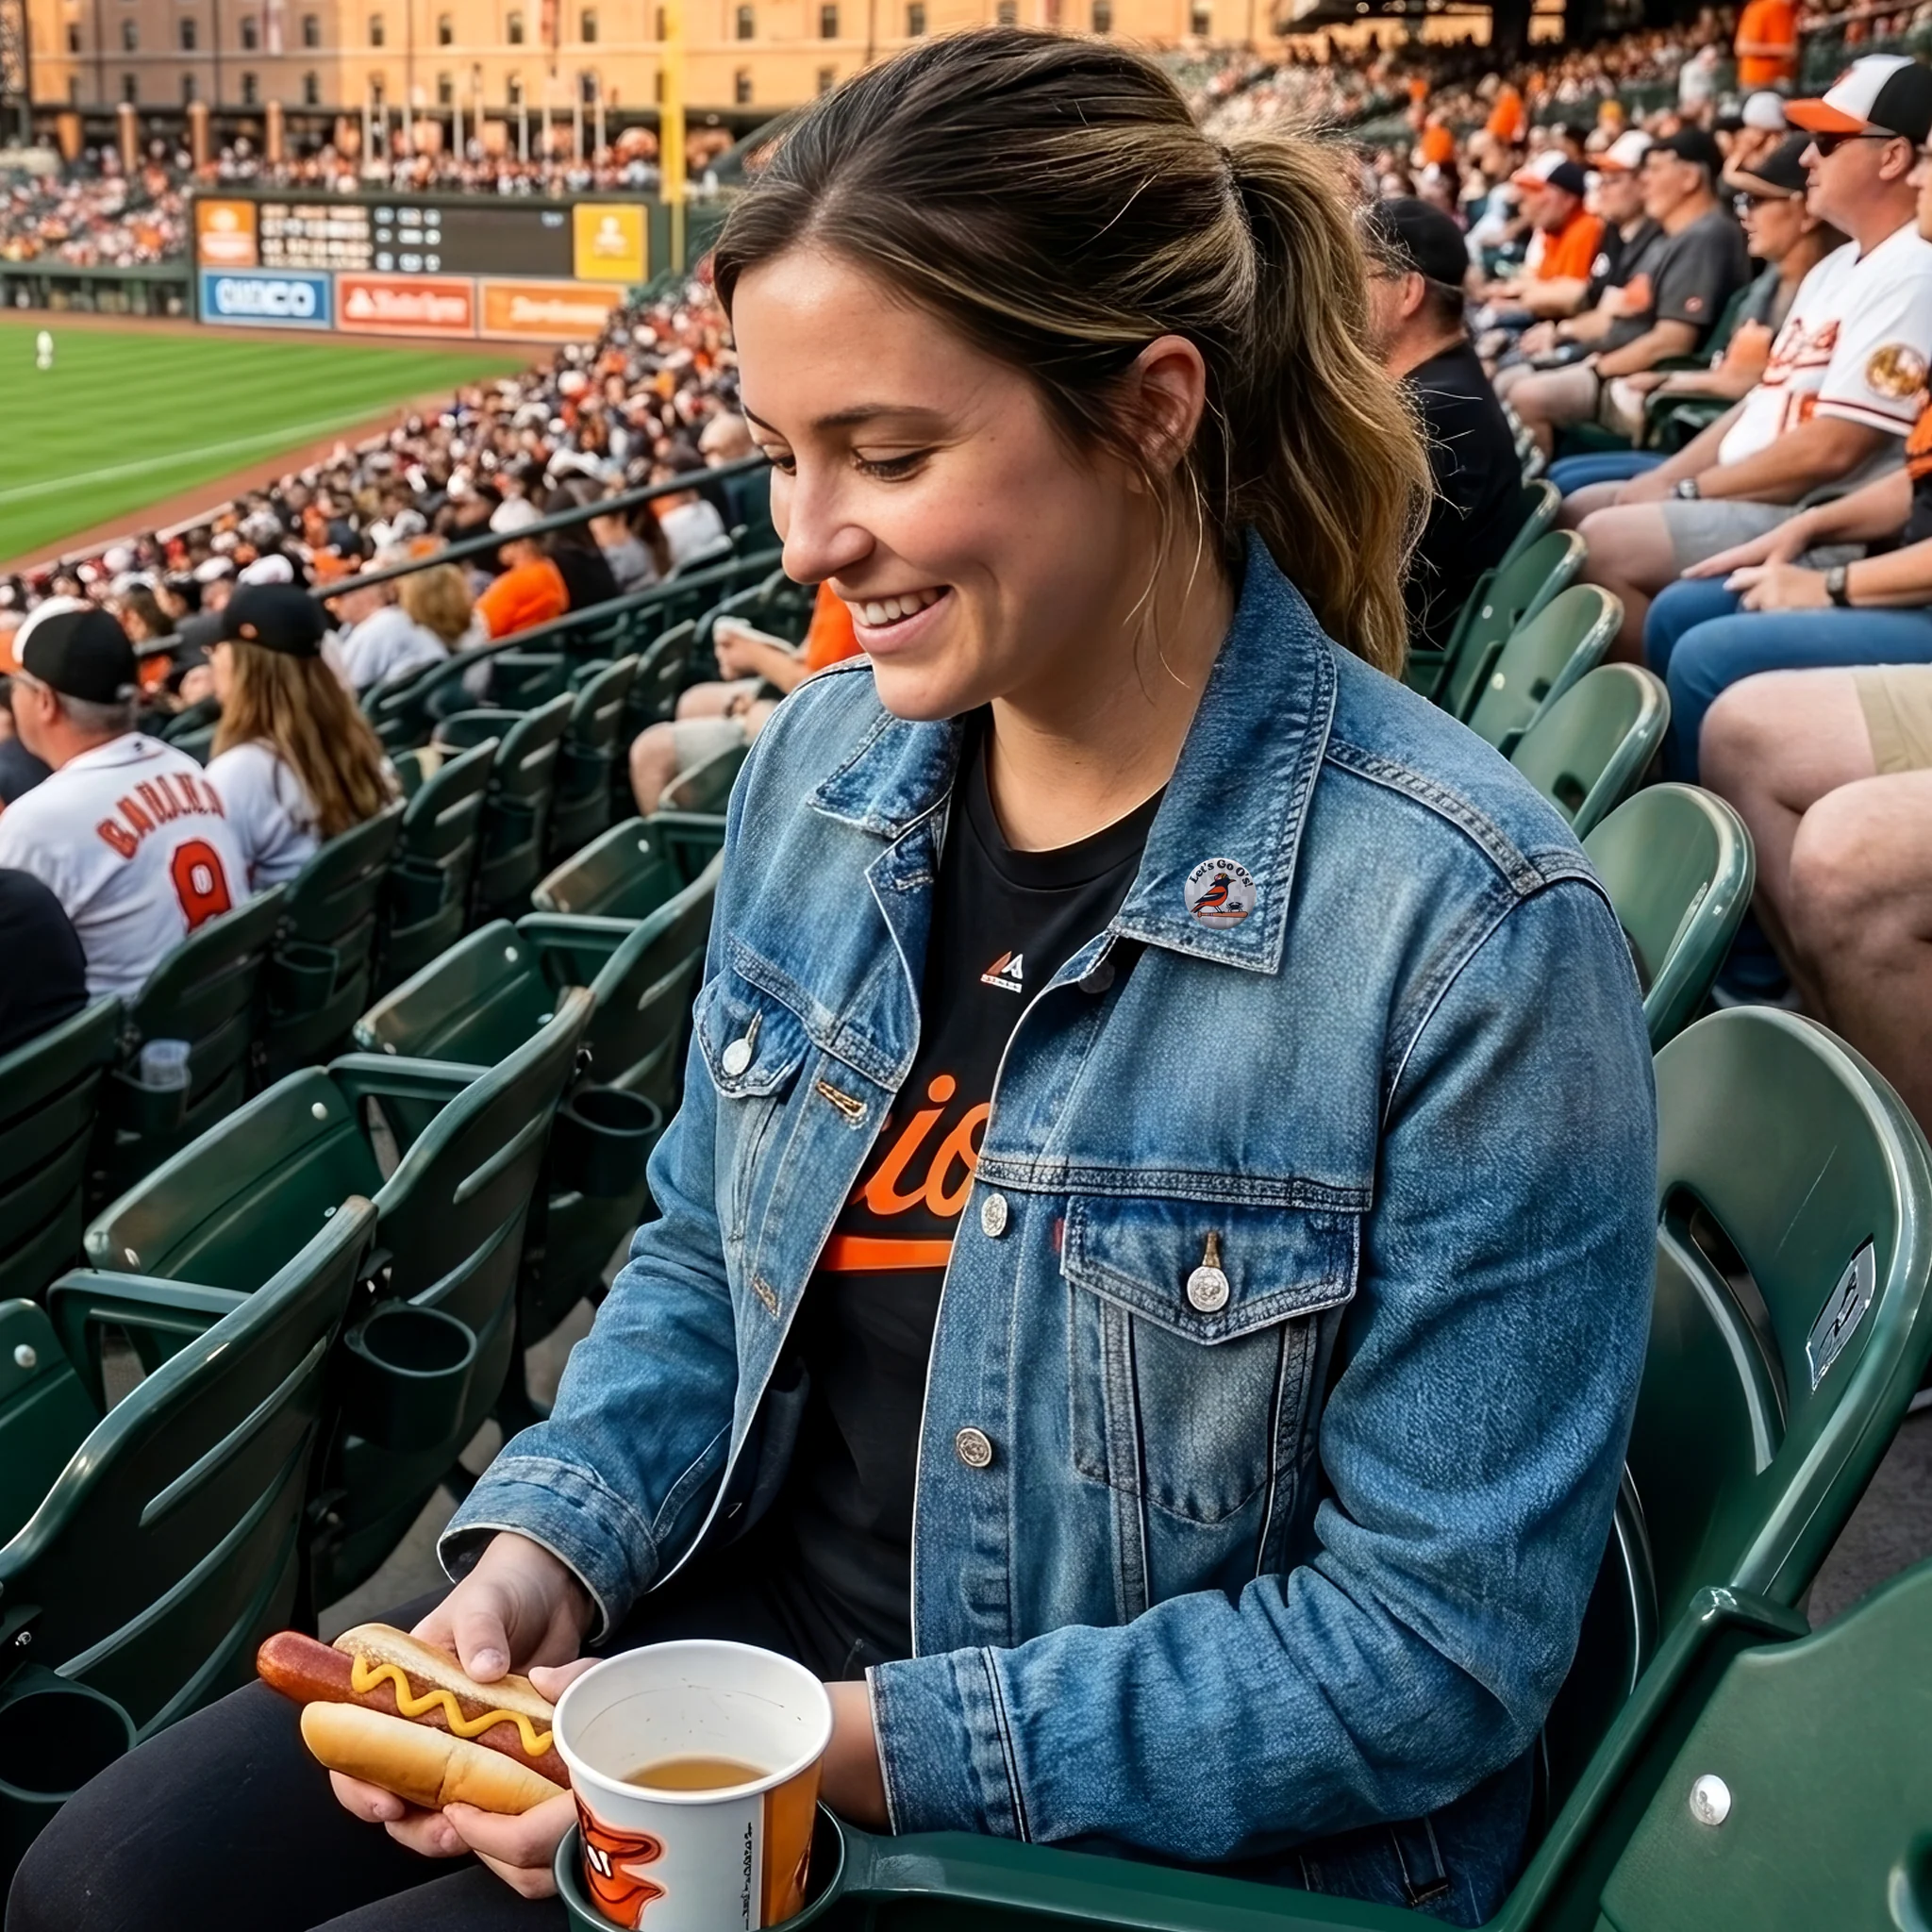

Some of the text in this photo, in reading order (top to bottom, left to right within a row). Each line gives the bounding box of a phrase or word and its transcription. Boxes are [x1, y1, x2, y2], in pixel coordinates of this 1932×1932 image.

[1189, 858, 1254, 888] Let's Go O's!
